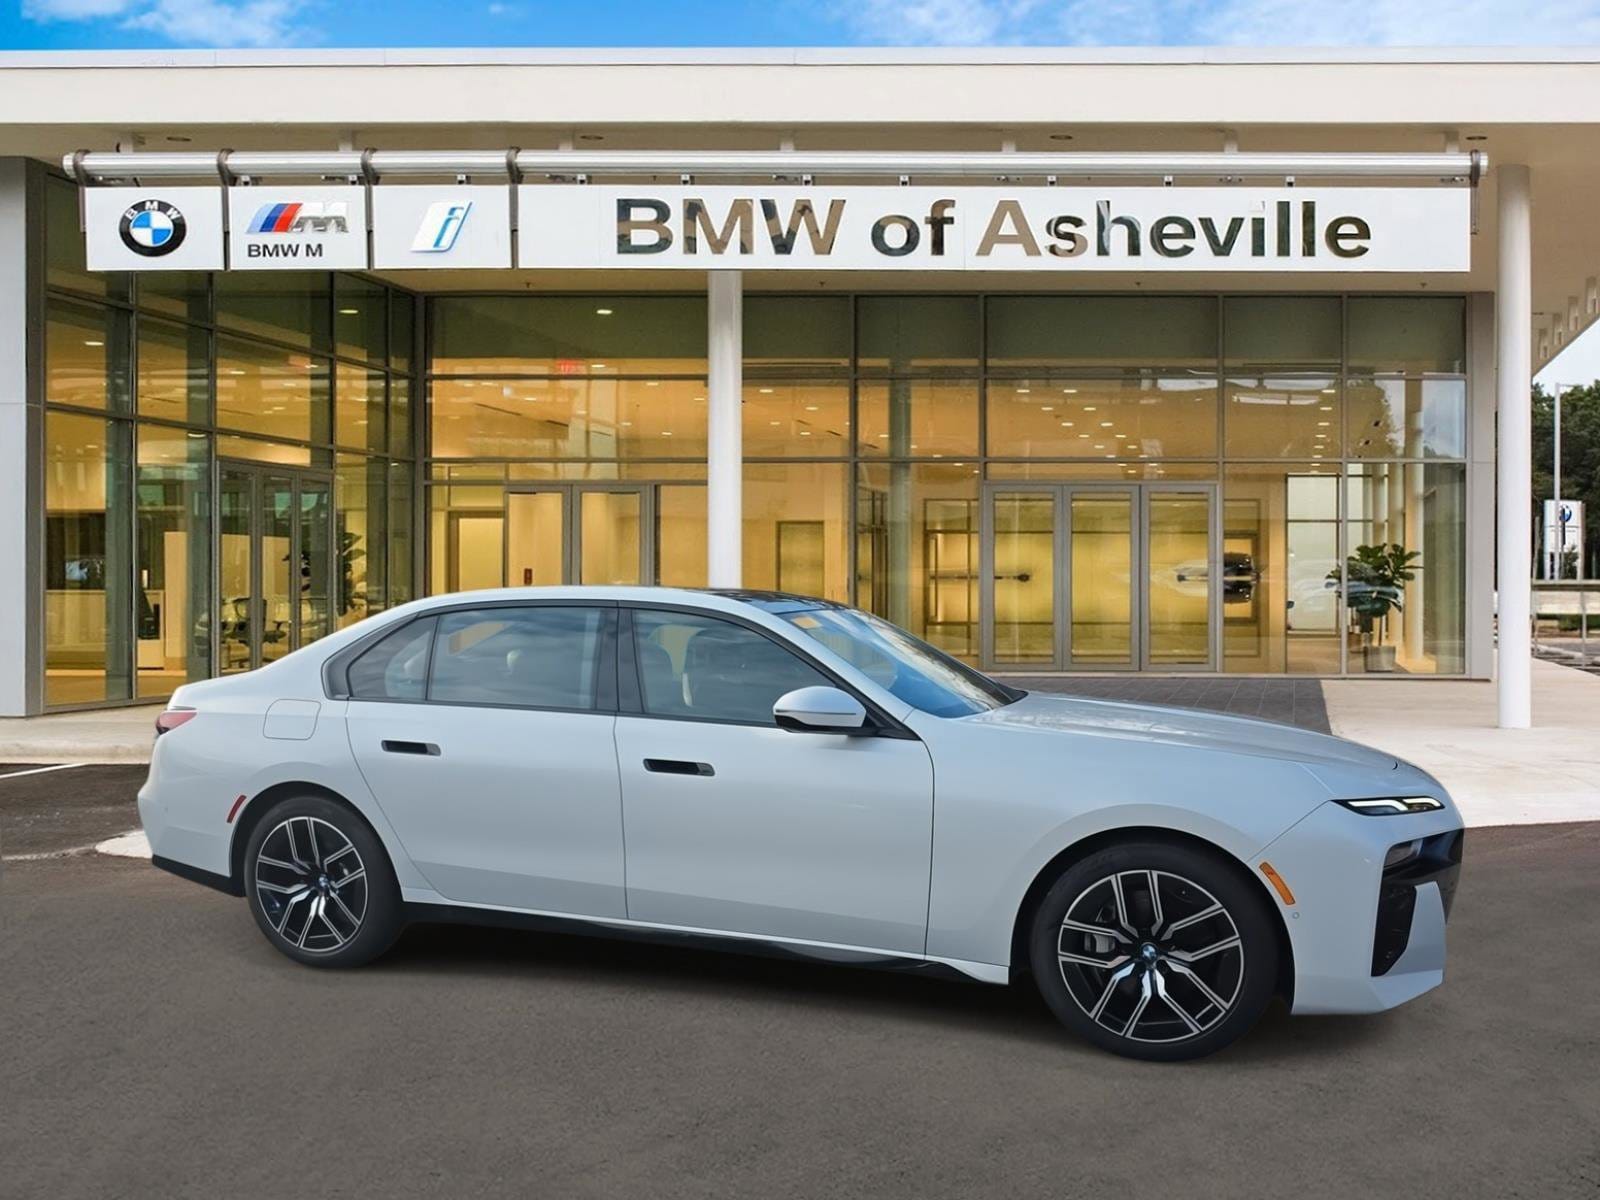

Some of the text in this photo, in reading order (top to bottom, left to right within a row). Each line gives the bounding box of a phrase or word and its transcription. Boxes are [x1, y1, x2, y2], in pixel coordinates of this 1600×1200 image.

[125, 200, 181, 220] BMW
[616, 198, 1372, 258] BMW of Asheville
[247, 243, 324, 258] BMW M
